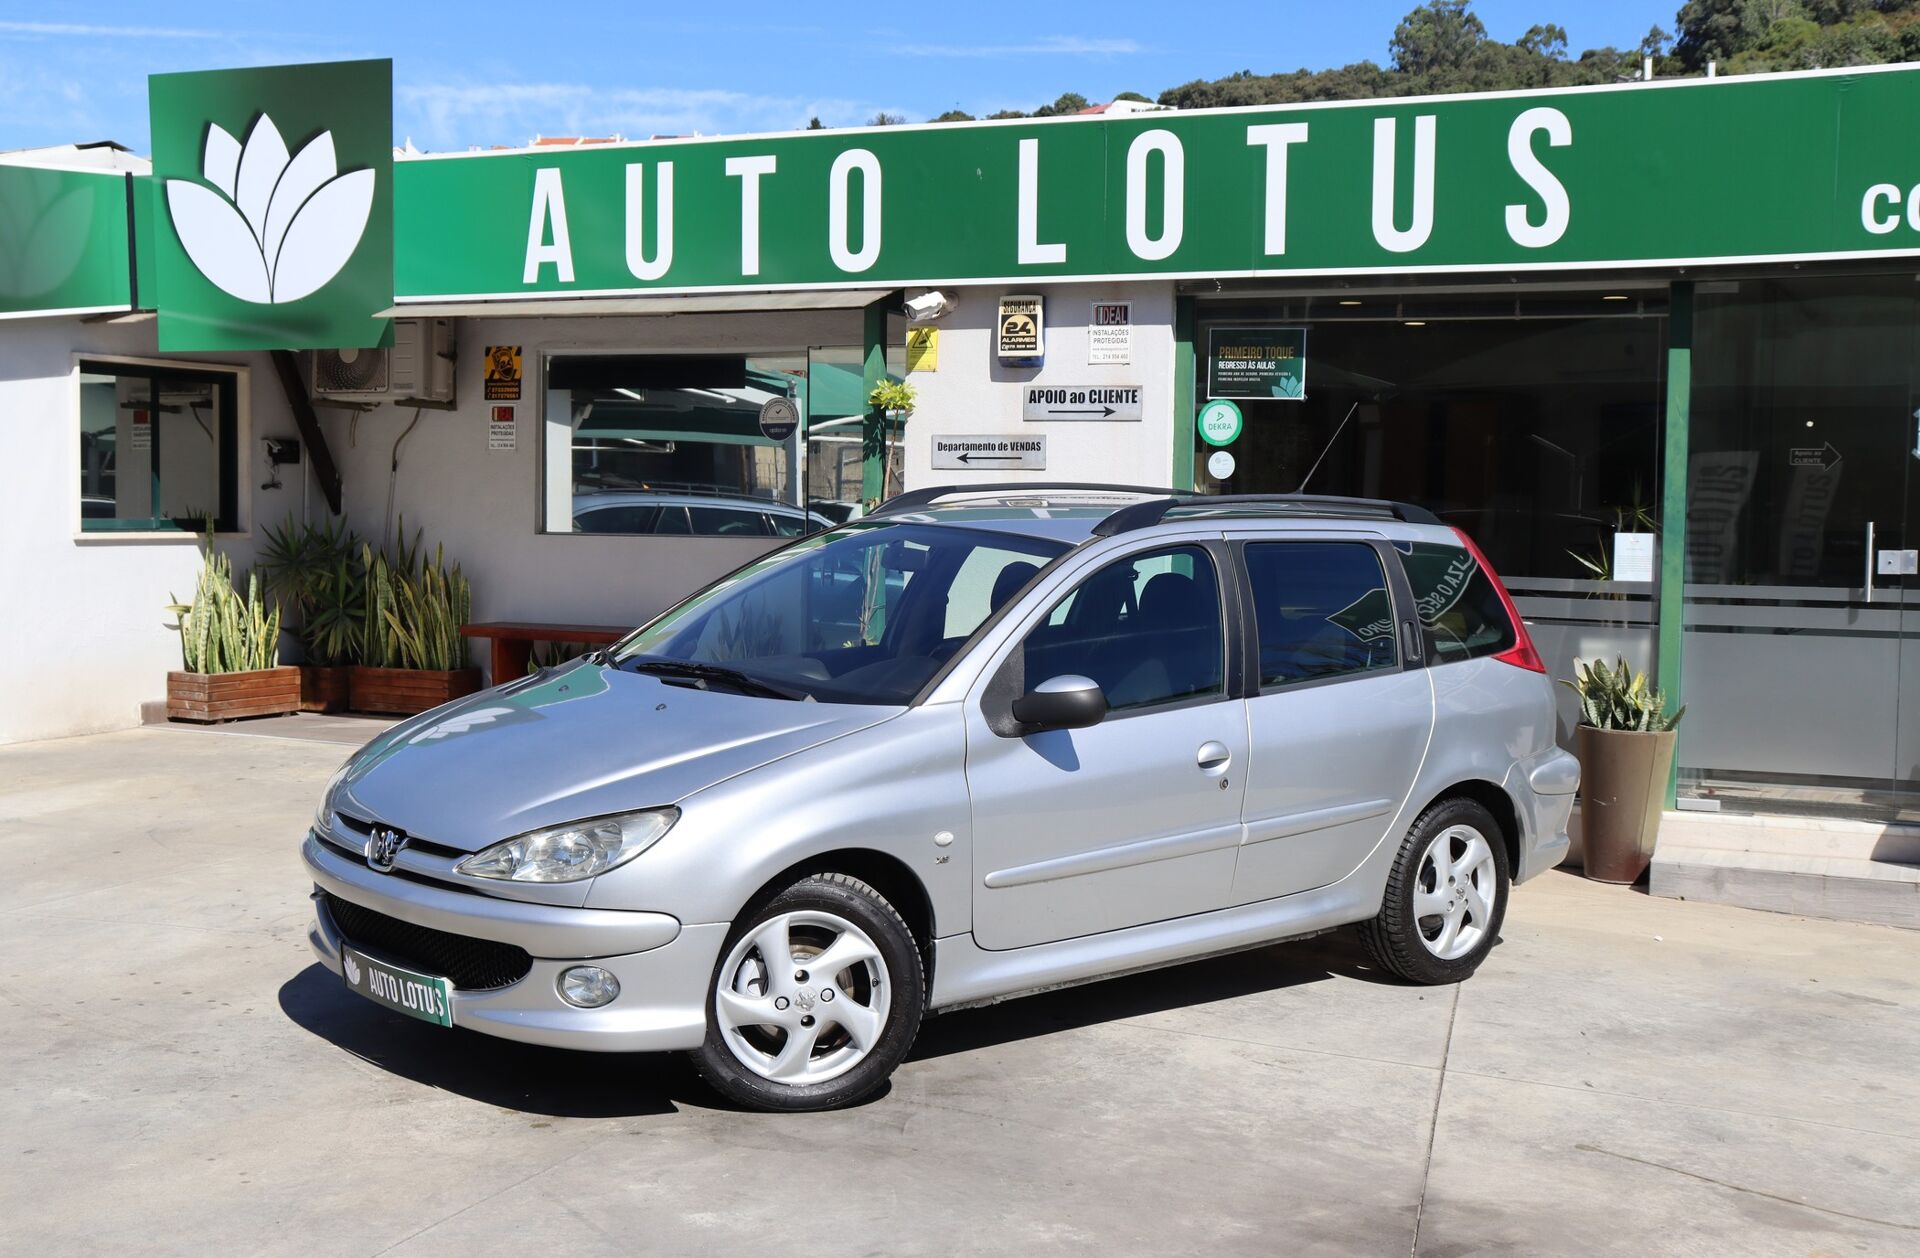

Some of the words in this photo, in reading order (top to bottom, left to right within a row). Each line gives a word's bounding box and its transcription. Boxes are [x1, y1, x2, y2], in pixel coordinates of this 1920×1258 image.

[522, 148, 882, 284] AUTO
[1017, 106, 1573, 264] LOTUS
[1005, 321, 1031, 335] 24
[1092, 329, 1129, 337] INSTALAÇÕES
[1219, 346, 1263, 359] PRIMEIRO
[1264, 346, 1295, 360] TOQUE
[1218, 361, 1247, 370] REGRESSO
[1247, 360, 1256, 370] ÀS
[1256, 361, 1276, 370] AULAS
[1028, 389, 1067, 404] APOIO
[1069, 391, 1086, 404] ao
[1088, 389, 1138, 404] CLIENTE
[1208, 423, 1233, 431] DEKRA
[937, 441, 996, 452] Departamento
[997, 441, 1009, 452] de
[1010, 441, 1042, 452] VENDAS
[368, 967, 399, 1003] AUTO
[399, 978, 445, 1017] LOTUS
